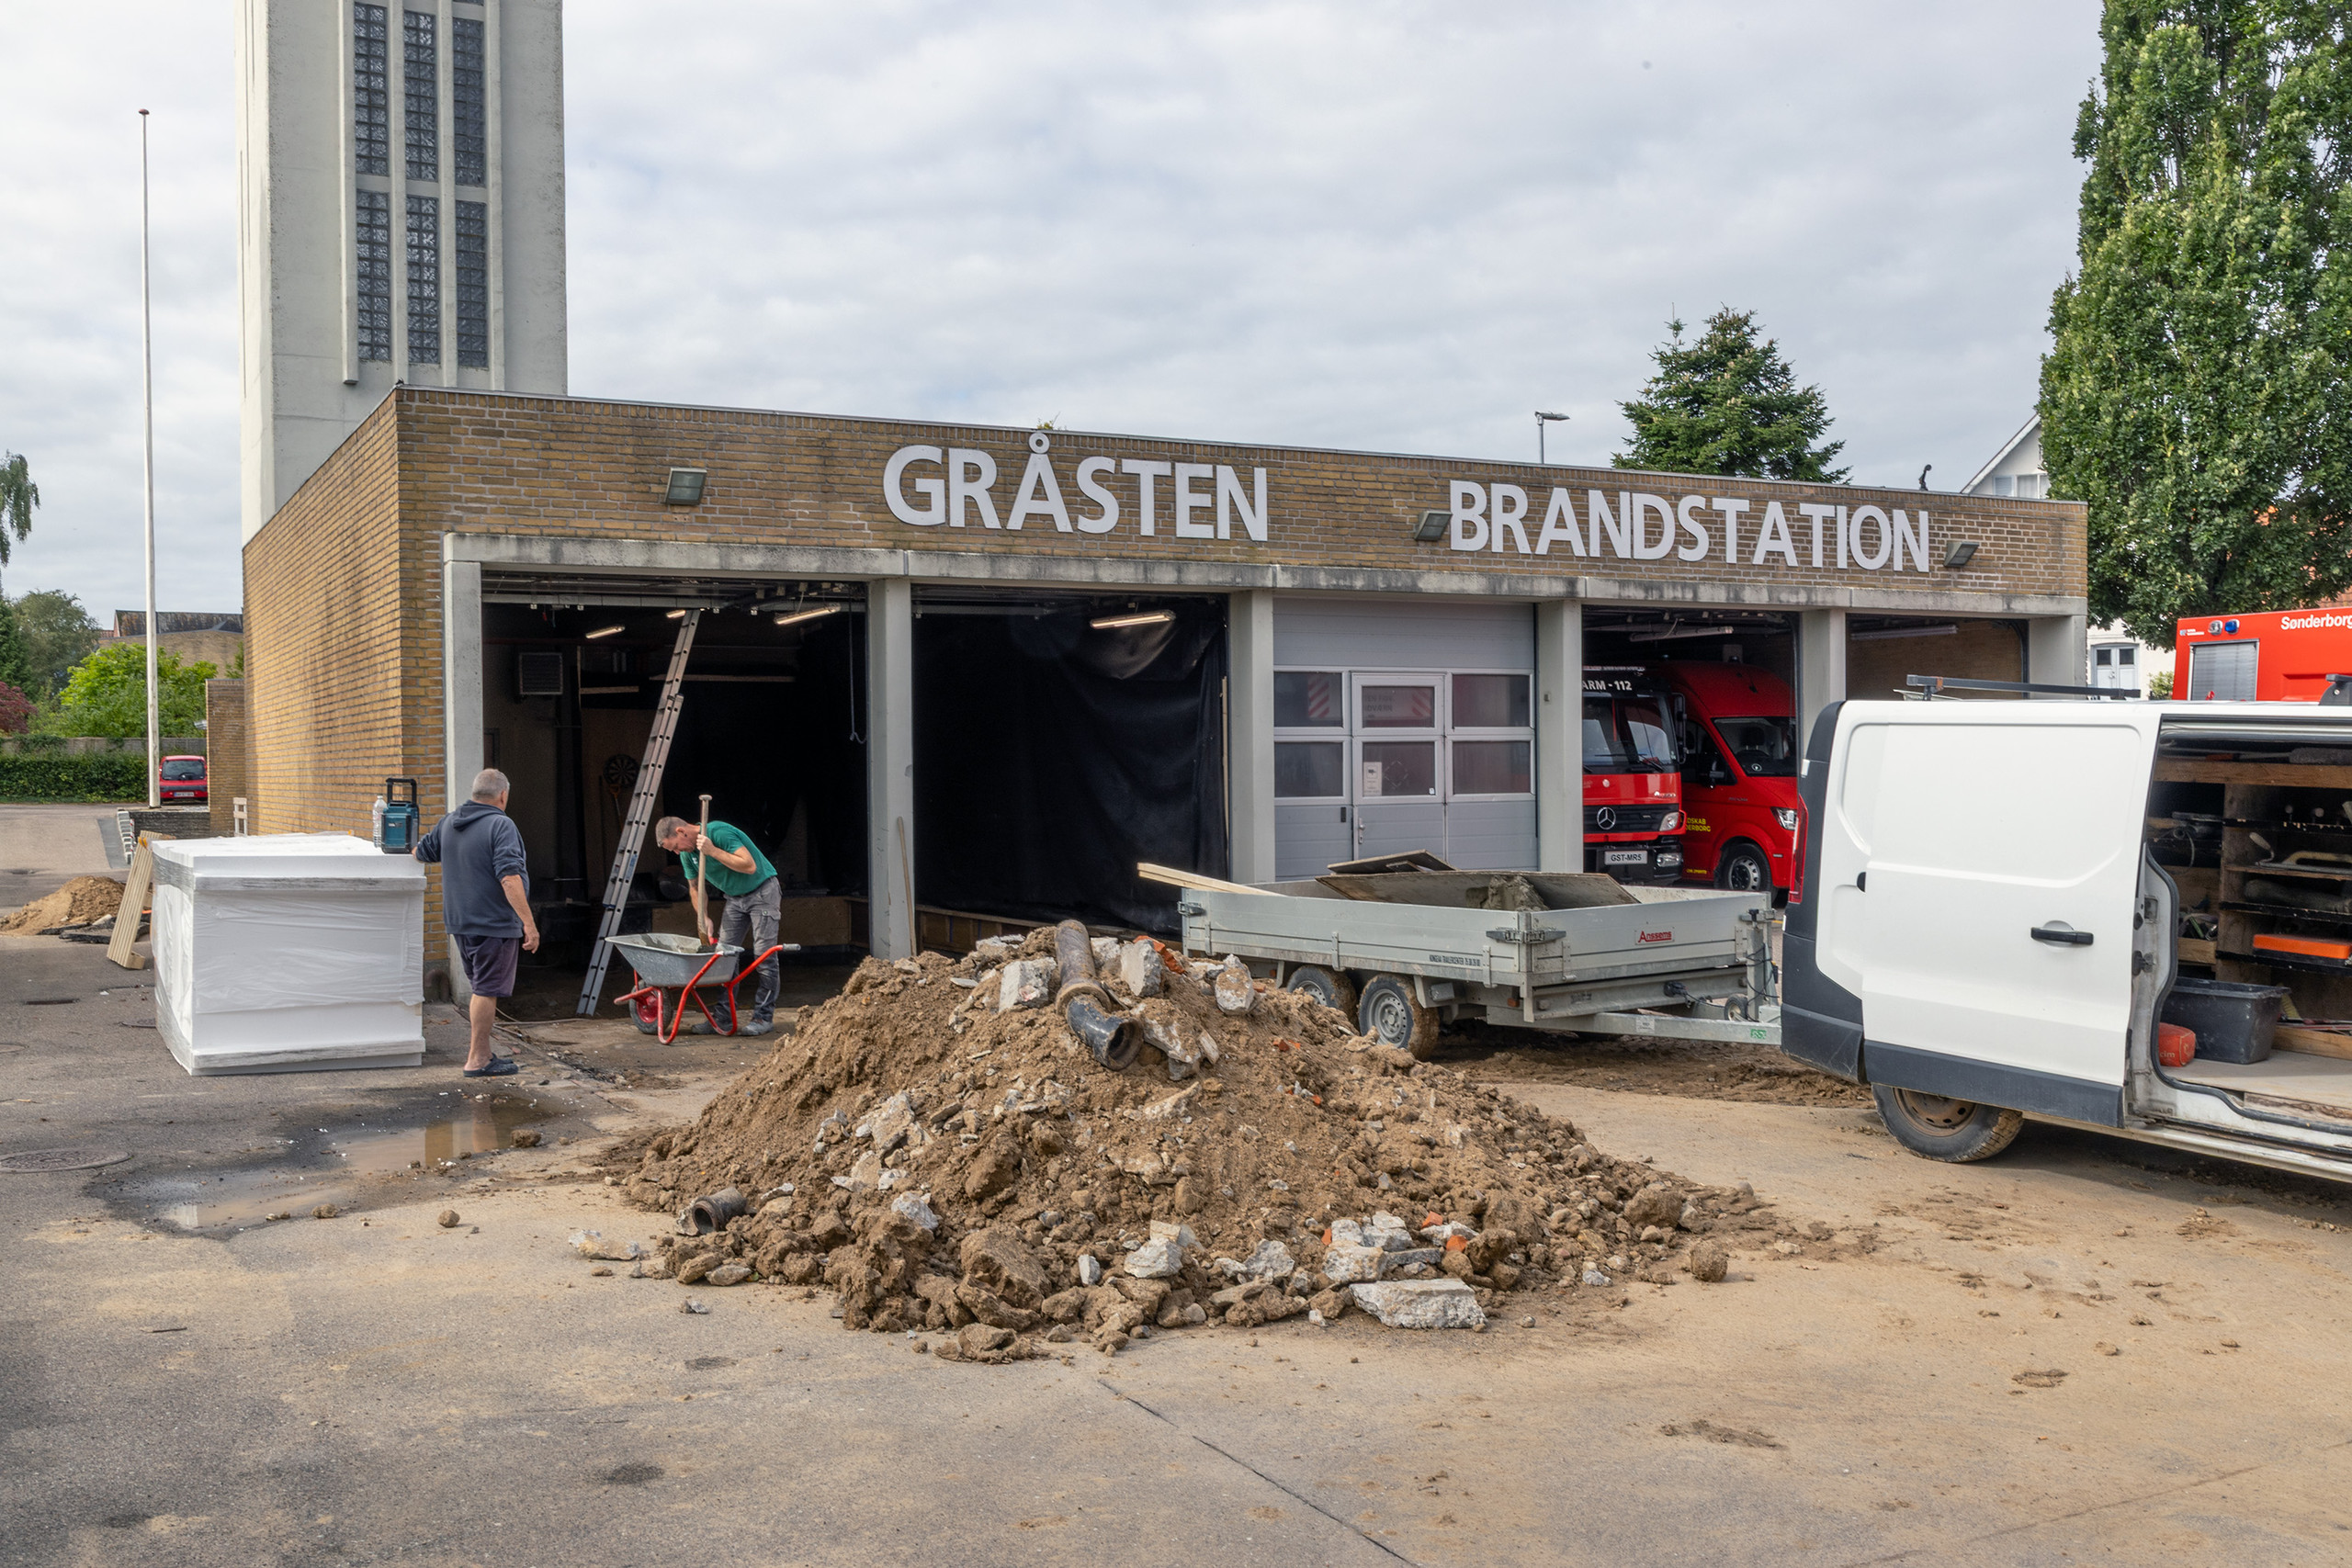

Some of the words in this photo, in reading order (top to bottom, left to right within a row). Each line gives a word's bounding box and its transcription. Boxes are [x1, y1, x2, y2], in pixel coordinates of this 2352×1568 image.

[883, 432, 1268, 542] GRÅSTEN
[1450, 479, 1929, 573] BRANDSTATION
[2280, 613, 2352, 630] Sønderborg
[1614, 680, 1633, 691] 112
[1637, 931, 1672, 942] Anssems
